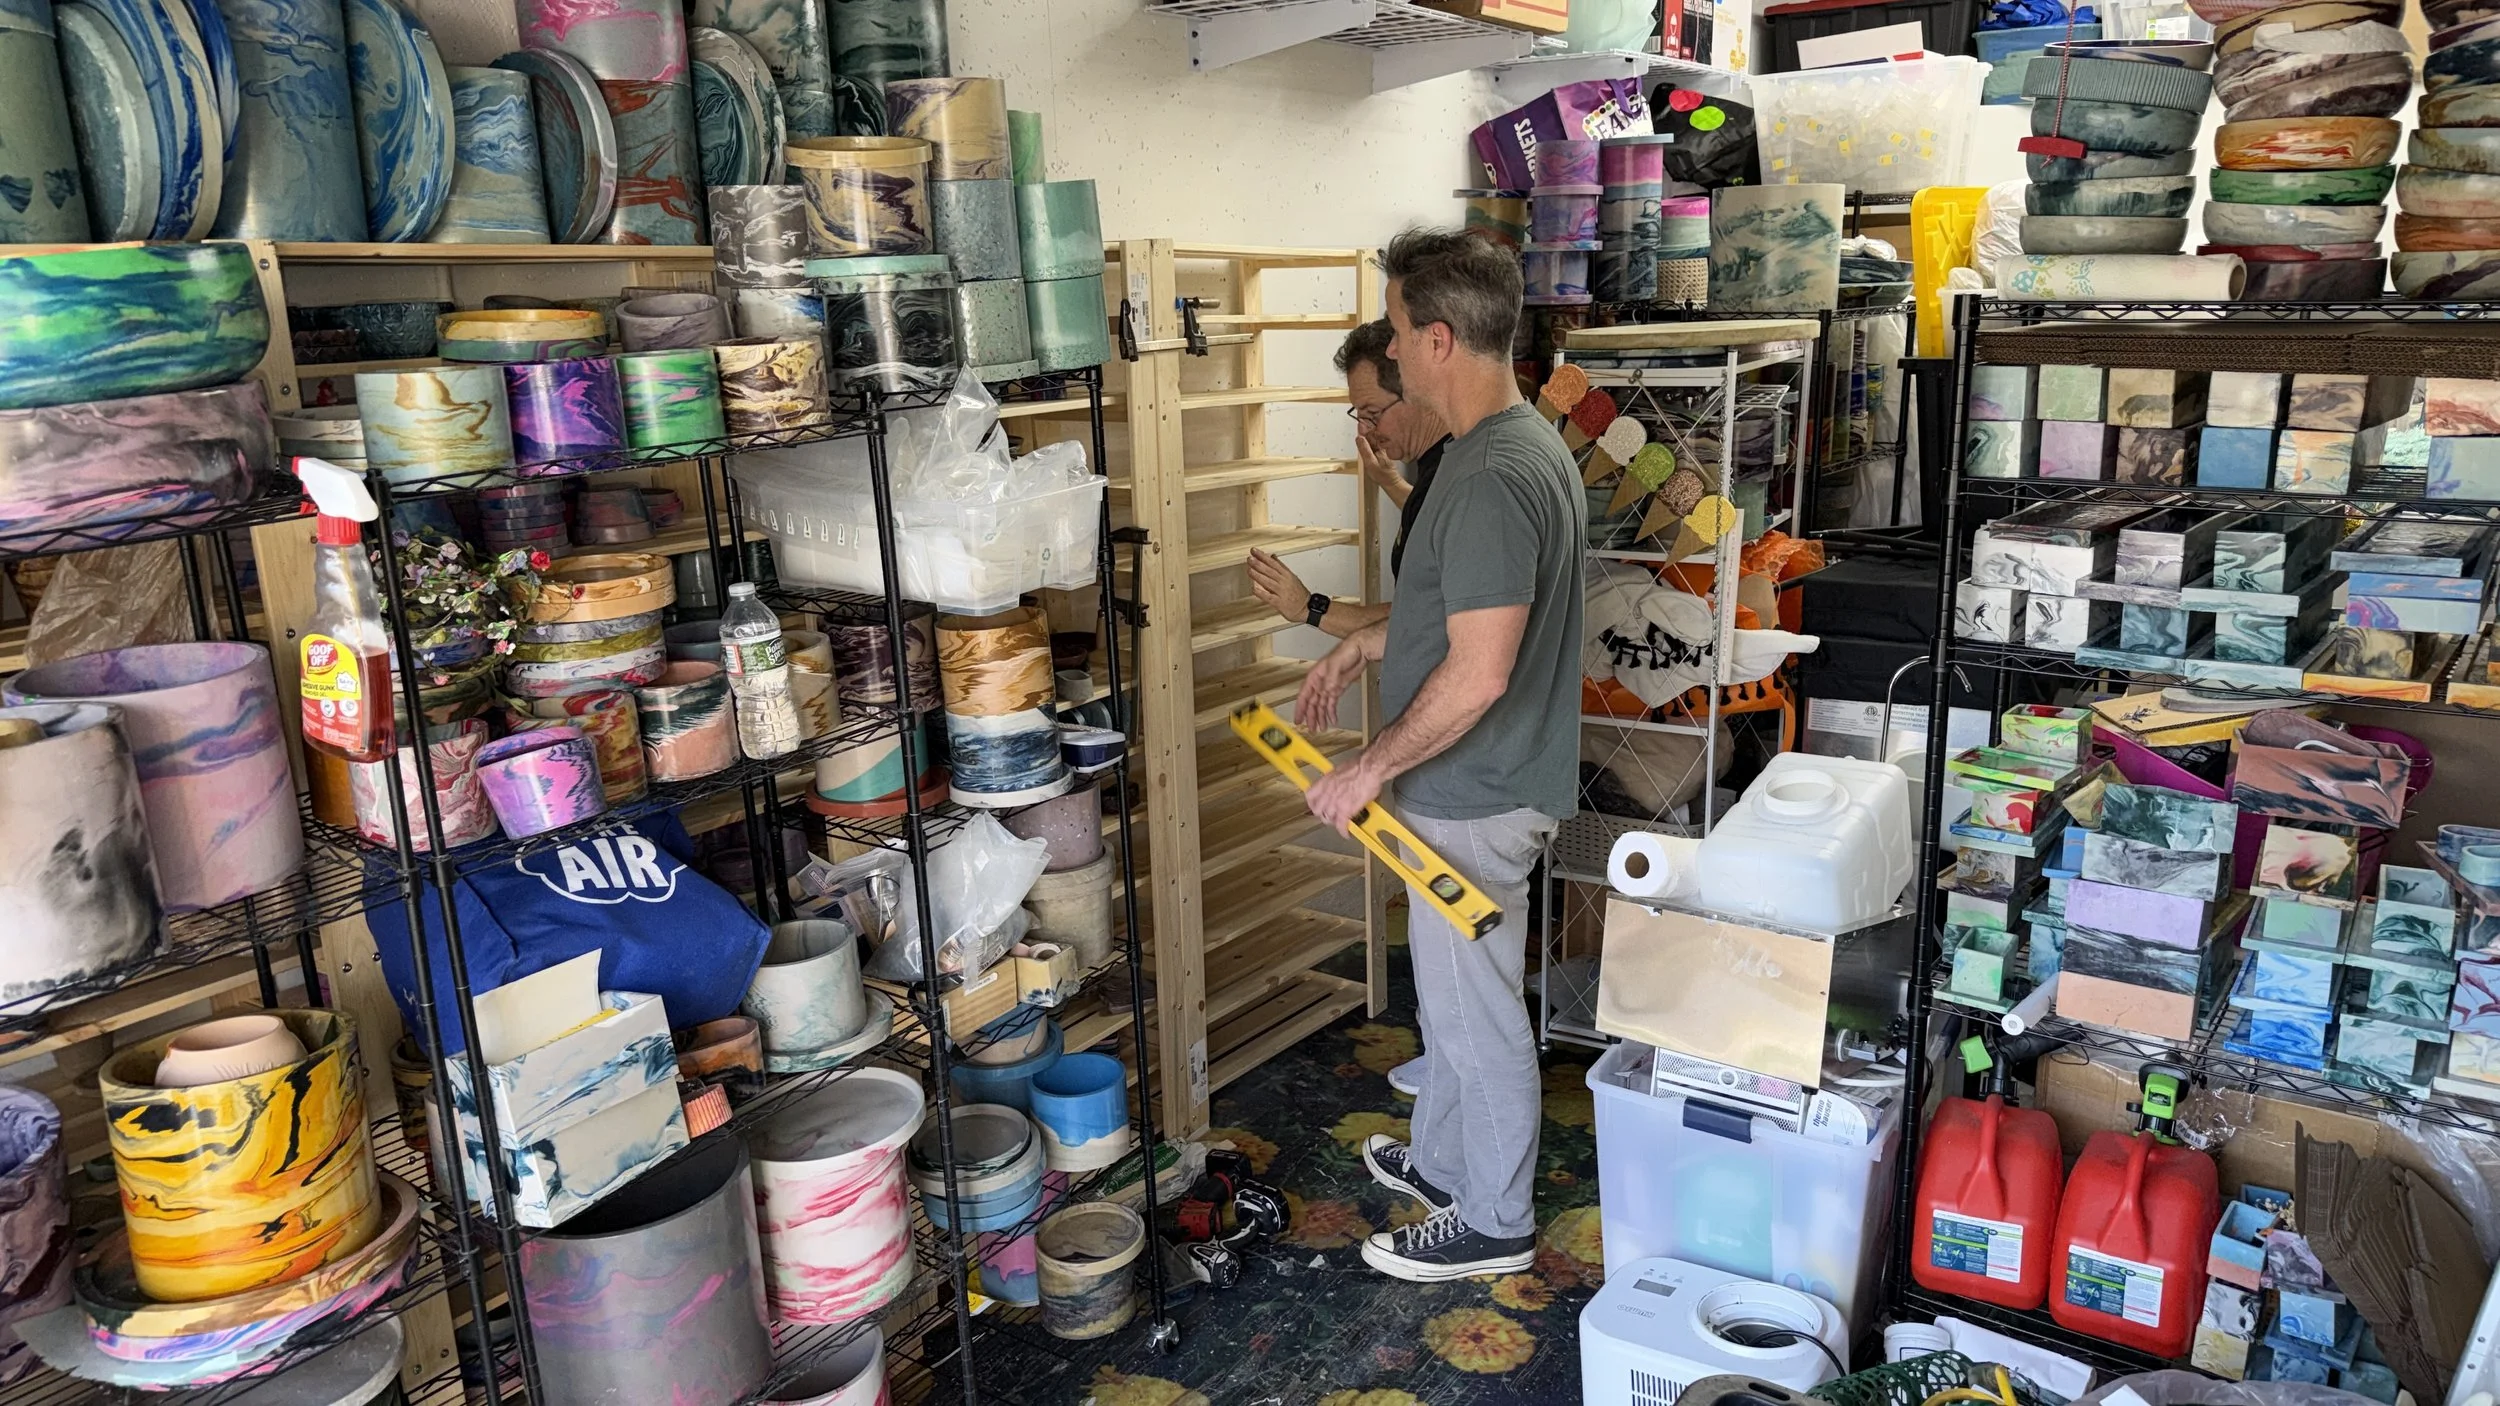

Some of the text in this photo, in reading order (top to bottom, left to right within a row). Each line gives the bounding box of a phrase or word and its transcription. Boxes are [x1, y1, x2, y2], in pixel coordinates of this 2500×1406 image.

[308, 643, 335, 656] GOOF
[310, 655, 329, 667] OFF
[557, 835, 670, 893] AIR
[1813, 1099, 1825, 1127] thermo
[1820, 1098, 1833, 1127] hauser
